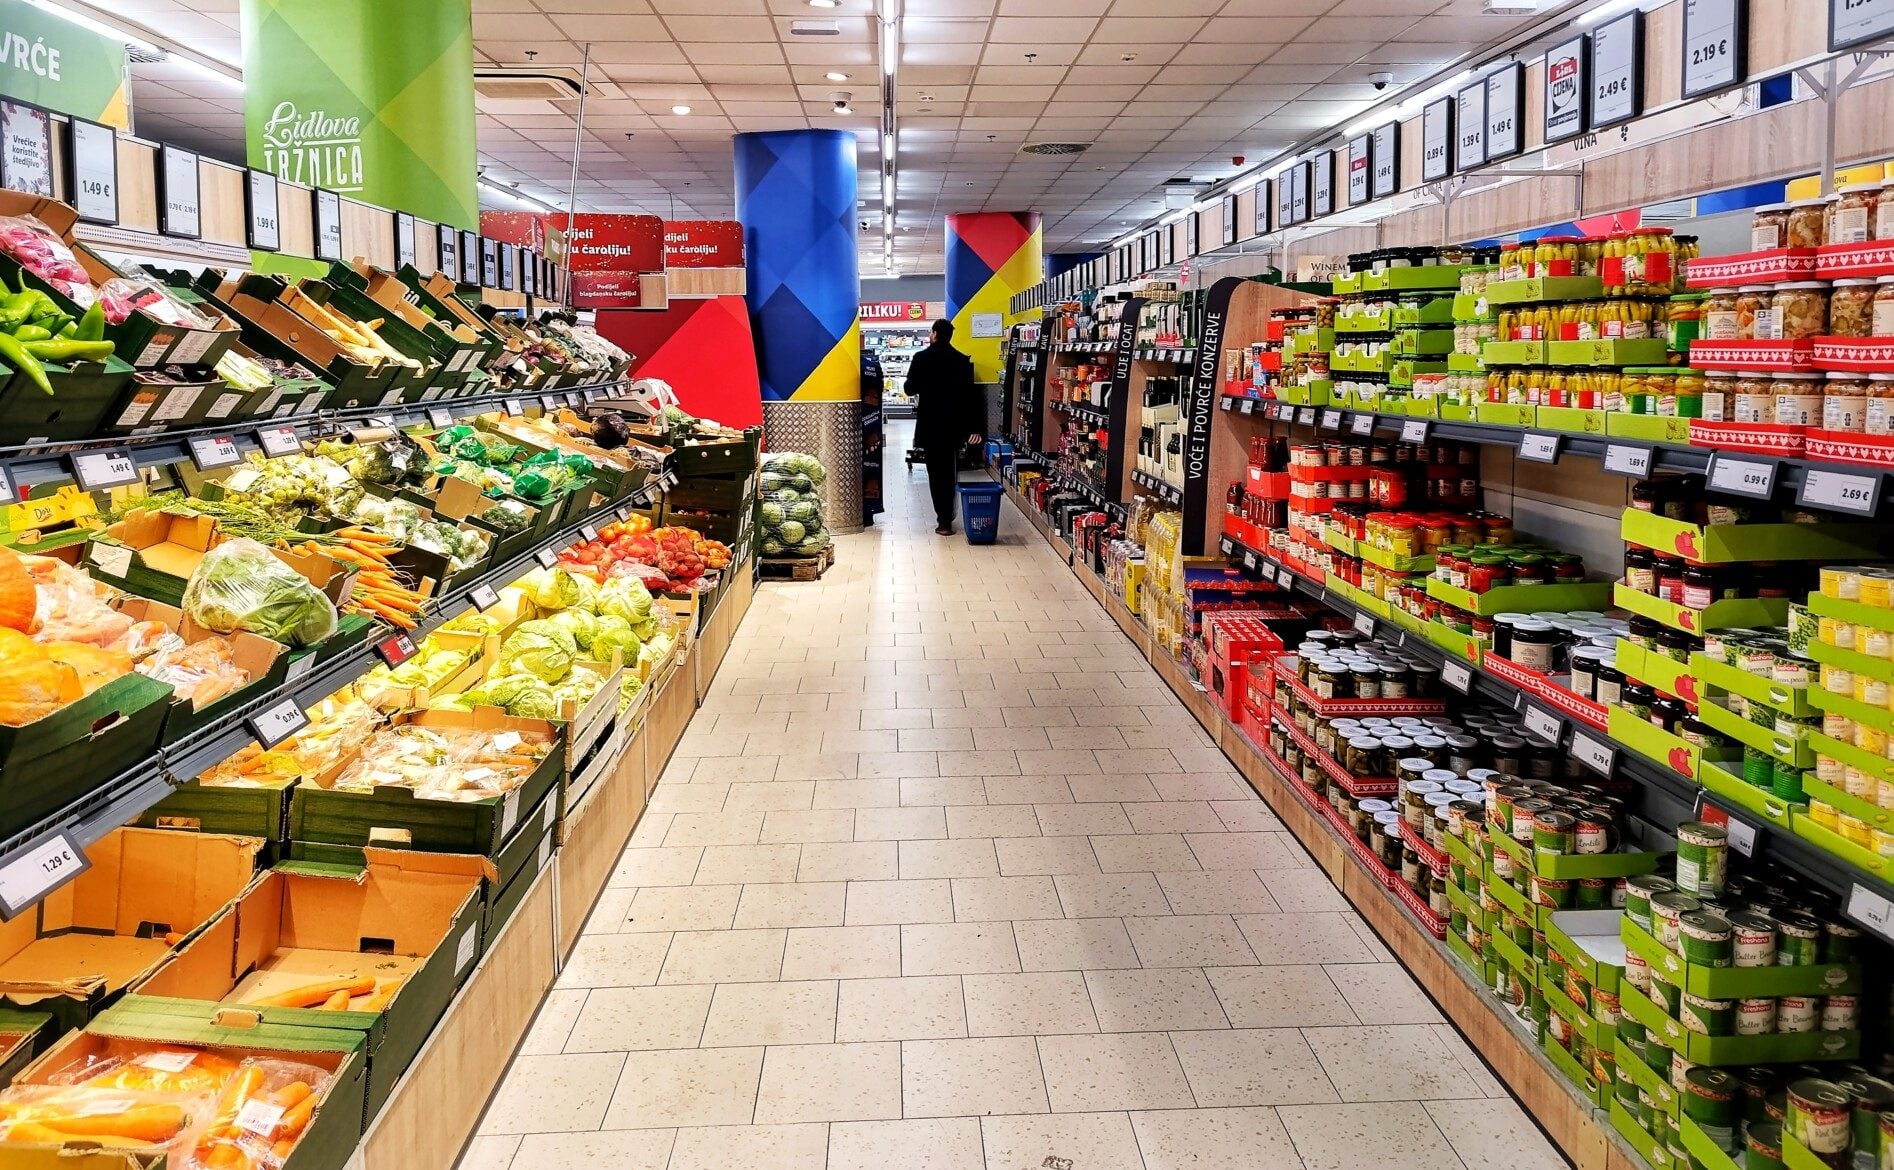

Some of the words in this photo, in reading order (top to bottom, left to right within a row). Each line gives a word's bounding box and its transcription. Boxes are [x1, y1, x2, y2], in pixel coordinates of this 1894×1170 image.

[0, 31, 61, 82] VRĆE
[1693, 43, 1716, 65] 2.19
[1718, 39, 1727, 55] €
[1552, 76, 1574, 98] CIJENA
[1599, 80, 1619, 100] 2.49
[1620, 77, 1627, 91] €
[263, 101, 360, 148] Lidlova
[1492, 120, 1506, 136] 1.49
[1506, 118, 1512, 130] €
[13, 134, 37, 149] Vrećice
[1462, 134, 1475, 148] 1.39
[1475, 132, 1480, 143] €
[12, 145, 39, 159] koristite
[1426, 147, 1439, 161] 0.89
[1439, 145, 1444, 156] €
[12, 156, 40, 170] štedljivo
[264, 141, 364, 187] TRŽNICA
[1387, 165, 1391, 175] €
[82, 181, 102, 196] 1.49
[103, 184, 110, 197] €
[256, 216, 269, 229] 1.99
[269, 219, 275, 230] €
[664, 233, 689, 243] dijeli
[581, 244, 631, 257] čaroliju!
[679, 245, 718, 255] čaroliju!
[1310, 262, 1346, 271] WINEM
[1310, 274, 1323, 283] OF
[597, 283, 619, 291] Podijeli
[858, 304, 902, 318] RILIKU!
[1040, 334, 1049, 350] KAVE
[1123, 322, 1135, 348] OCAT
[1200, 311, 1222, 379] KONZERVE
[1116, 355, 1130, 379] ULJE
[1194, 381, 1212, 433] POVRĆE
[110, 463, 124, 474] 1.49
[123, 461, 130, 472] €
[1188, 444, 1203, 479] VOĆE
[1640, 459, 1646, 467] €
[1744, 473, 1761, 485] 0.99
[1761, 476, 1767, 486] €
[1842, 487, 1861, 501] 2.69
[1862, 491, 1869, 501] €
[282, 711, 295, 723] 0.79
[293, 709, 300, 717] €
[1553, 729, 1557, 737] €
[1593, 752, 1605, 764] 0.79
[1604, 758, 1609, 767] €
[42, 855, 62, 873] 1.29
[62, 850, 71, 861] €
[1735, 951, 1757, 960] Butter
